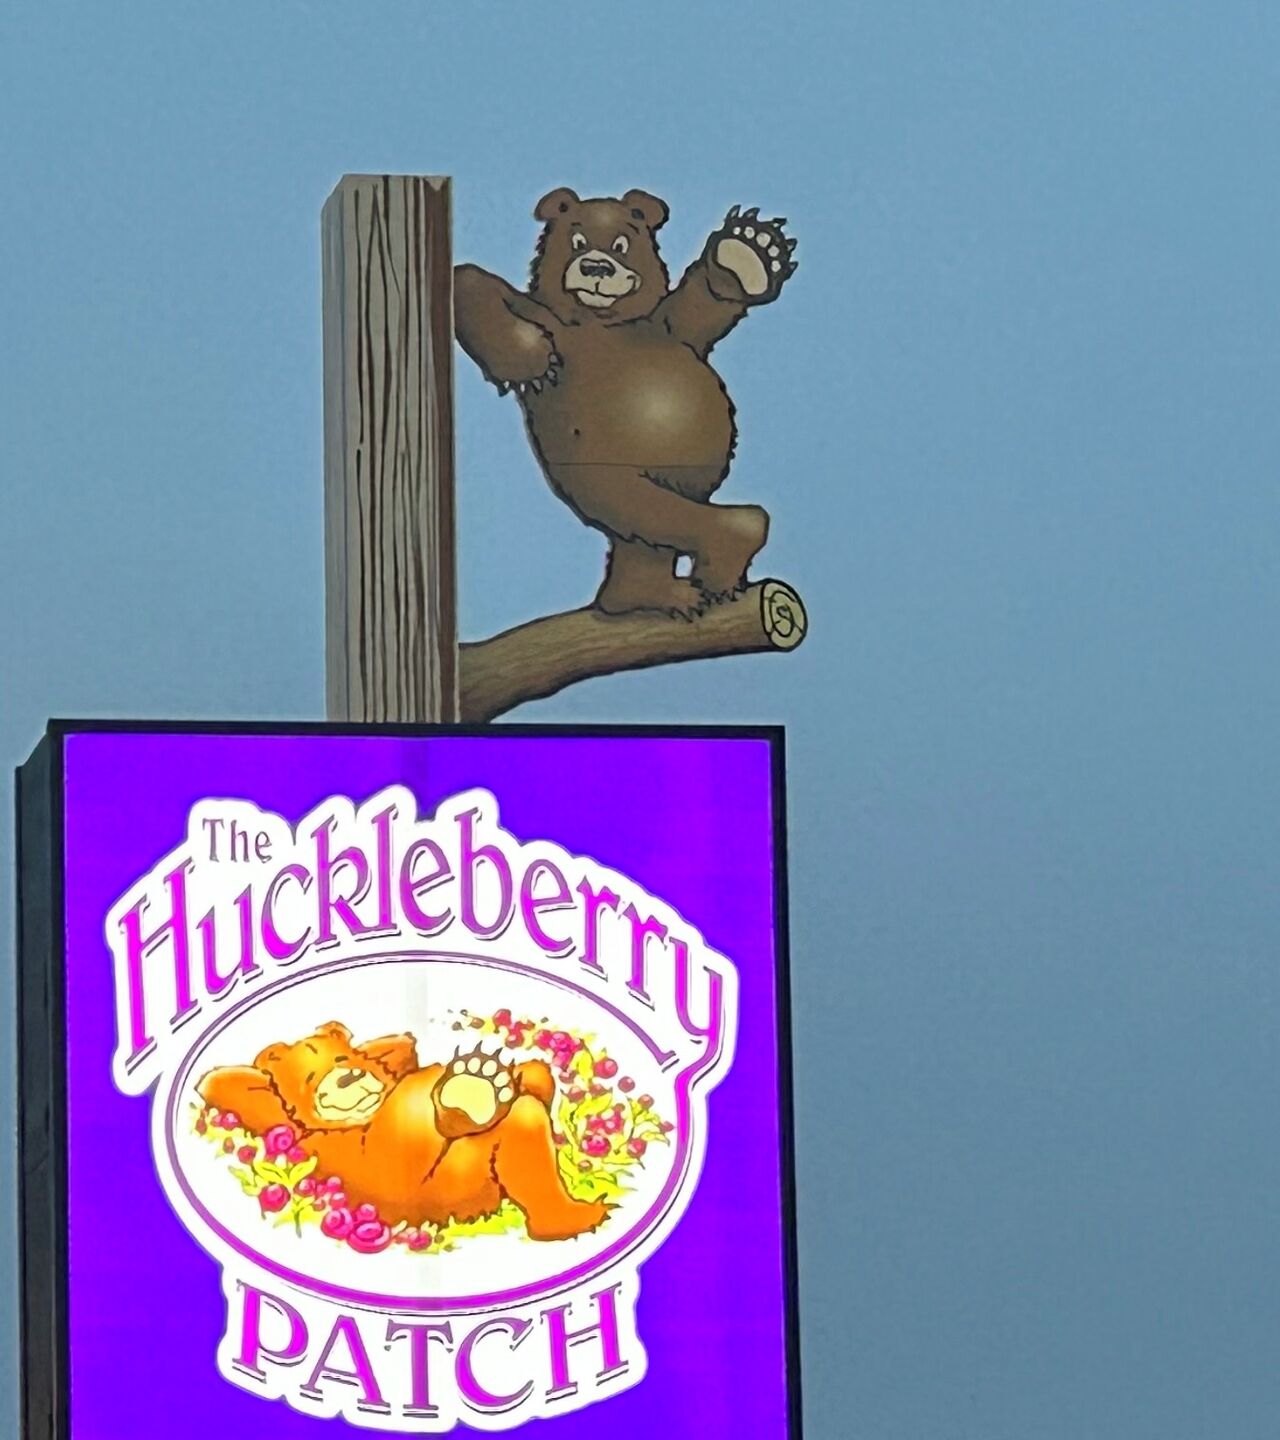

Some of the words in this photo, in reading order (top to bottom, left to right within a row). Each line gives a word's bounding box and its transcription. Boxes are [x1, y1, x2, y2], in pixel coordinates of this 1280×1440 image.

[202, 818, 273, 863] The
[118, 803, 727, 1070] Huckleberry
[231, 1279, 630, 1418] PATCH
